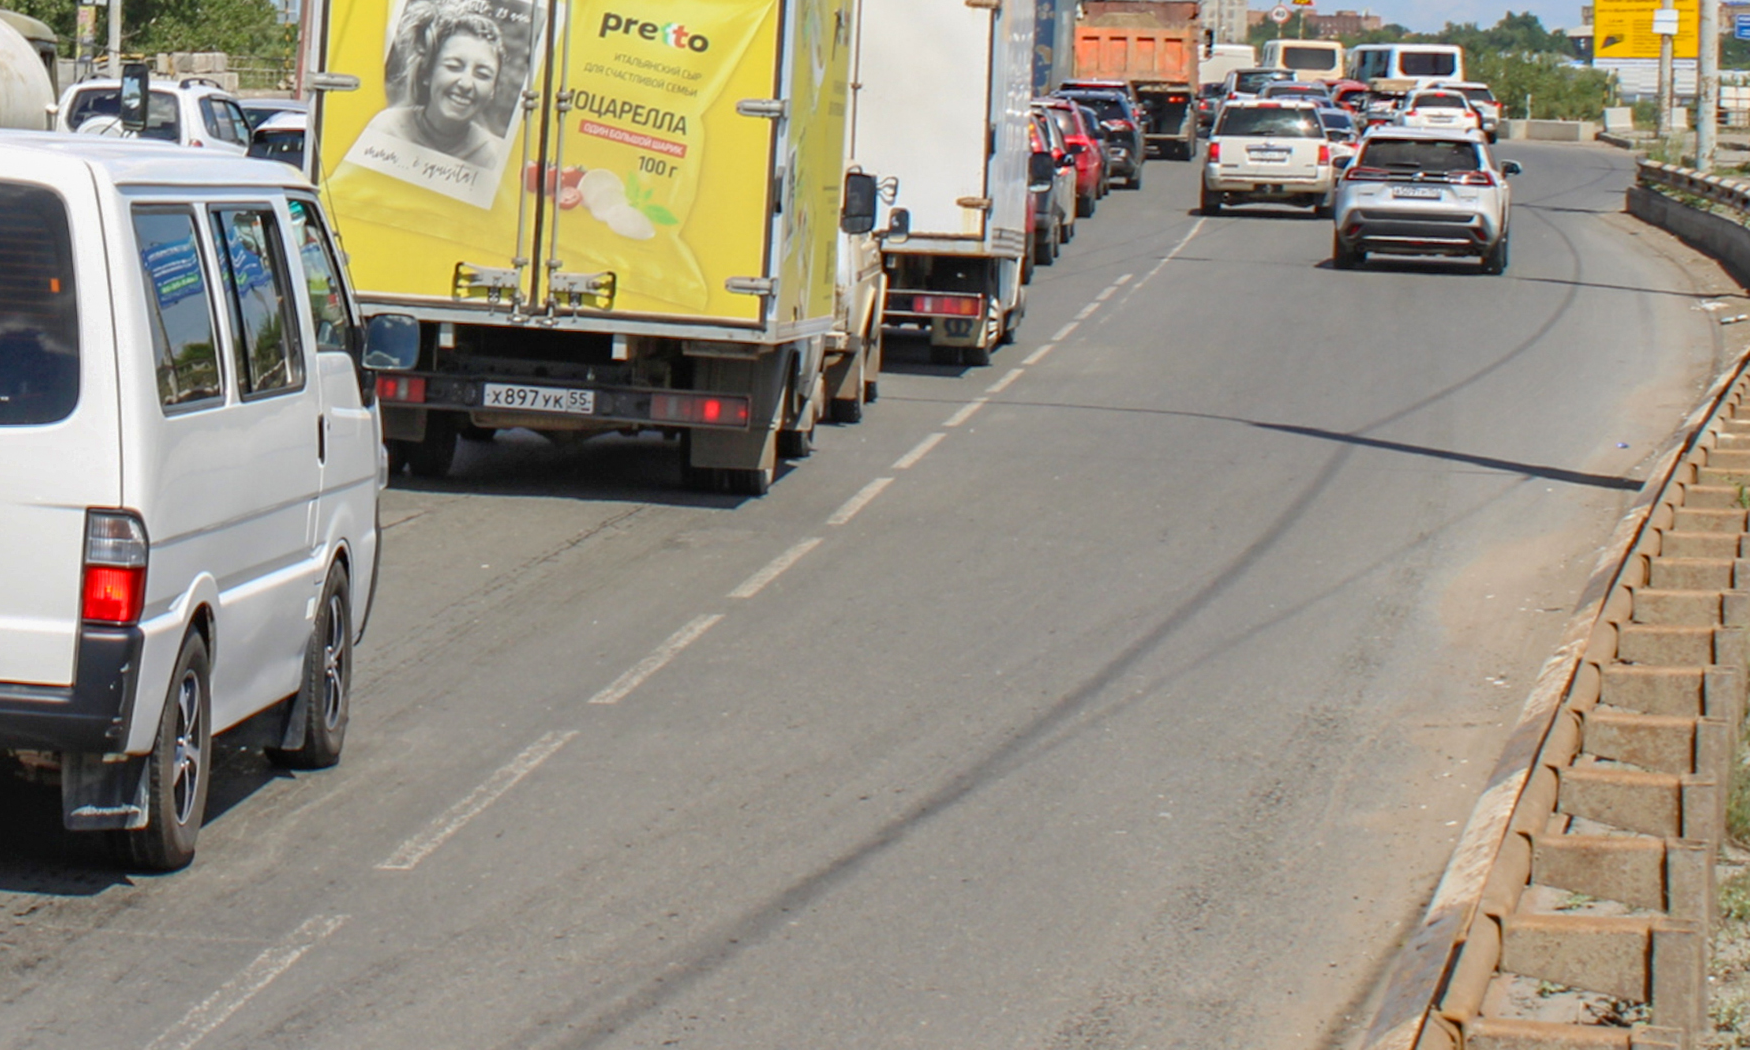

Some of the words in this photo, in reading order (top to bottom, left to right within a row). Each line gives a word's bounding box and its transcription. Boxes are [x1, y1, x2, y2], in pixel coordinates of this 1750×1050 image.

[598, 12, 709, 53] pretto
[584, 62, 604, 75] ДЛЯ
[605, 67, 665, 89] СЧАСТЛИВОЙ
[666, 82, 698, 97] СЕМЬИ
[614, 52, 681, 76] ИТАЛЬЯНСКИЙ
[681, 69, 703, 82] СЫР
[583, 122, 609, 137] ОДИН
[609, 128, 652, 147] БОЛЬШОЙ
[652, 138, 684, 155] ШАРИК
[639, 156, 666, 176] 100
